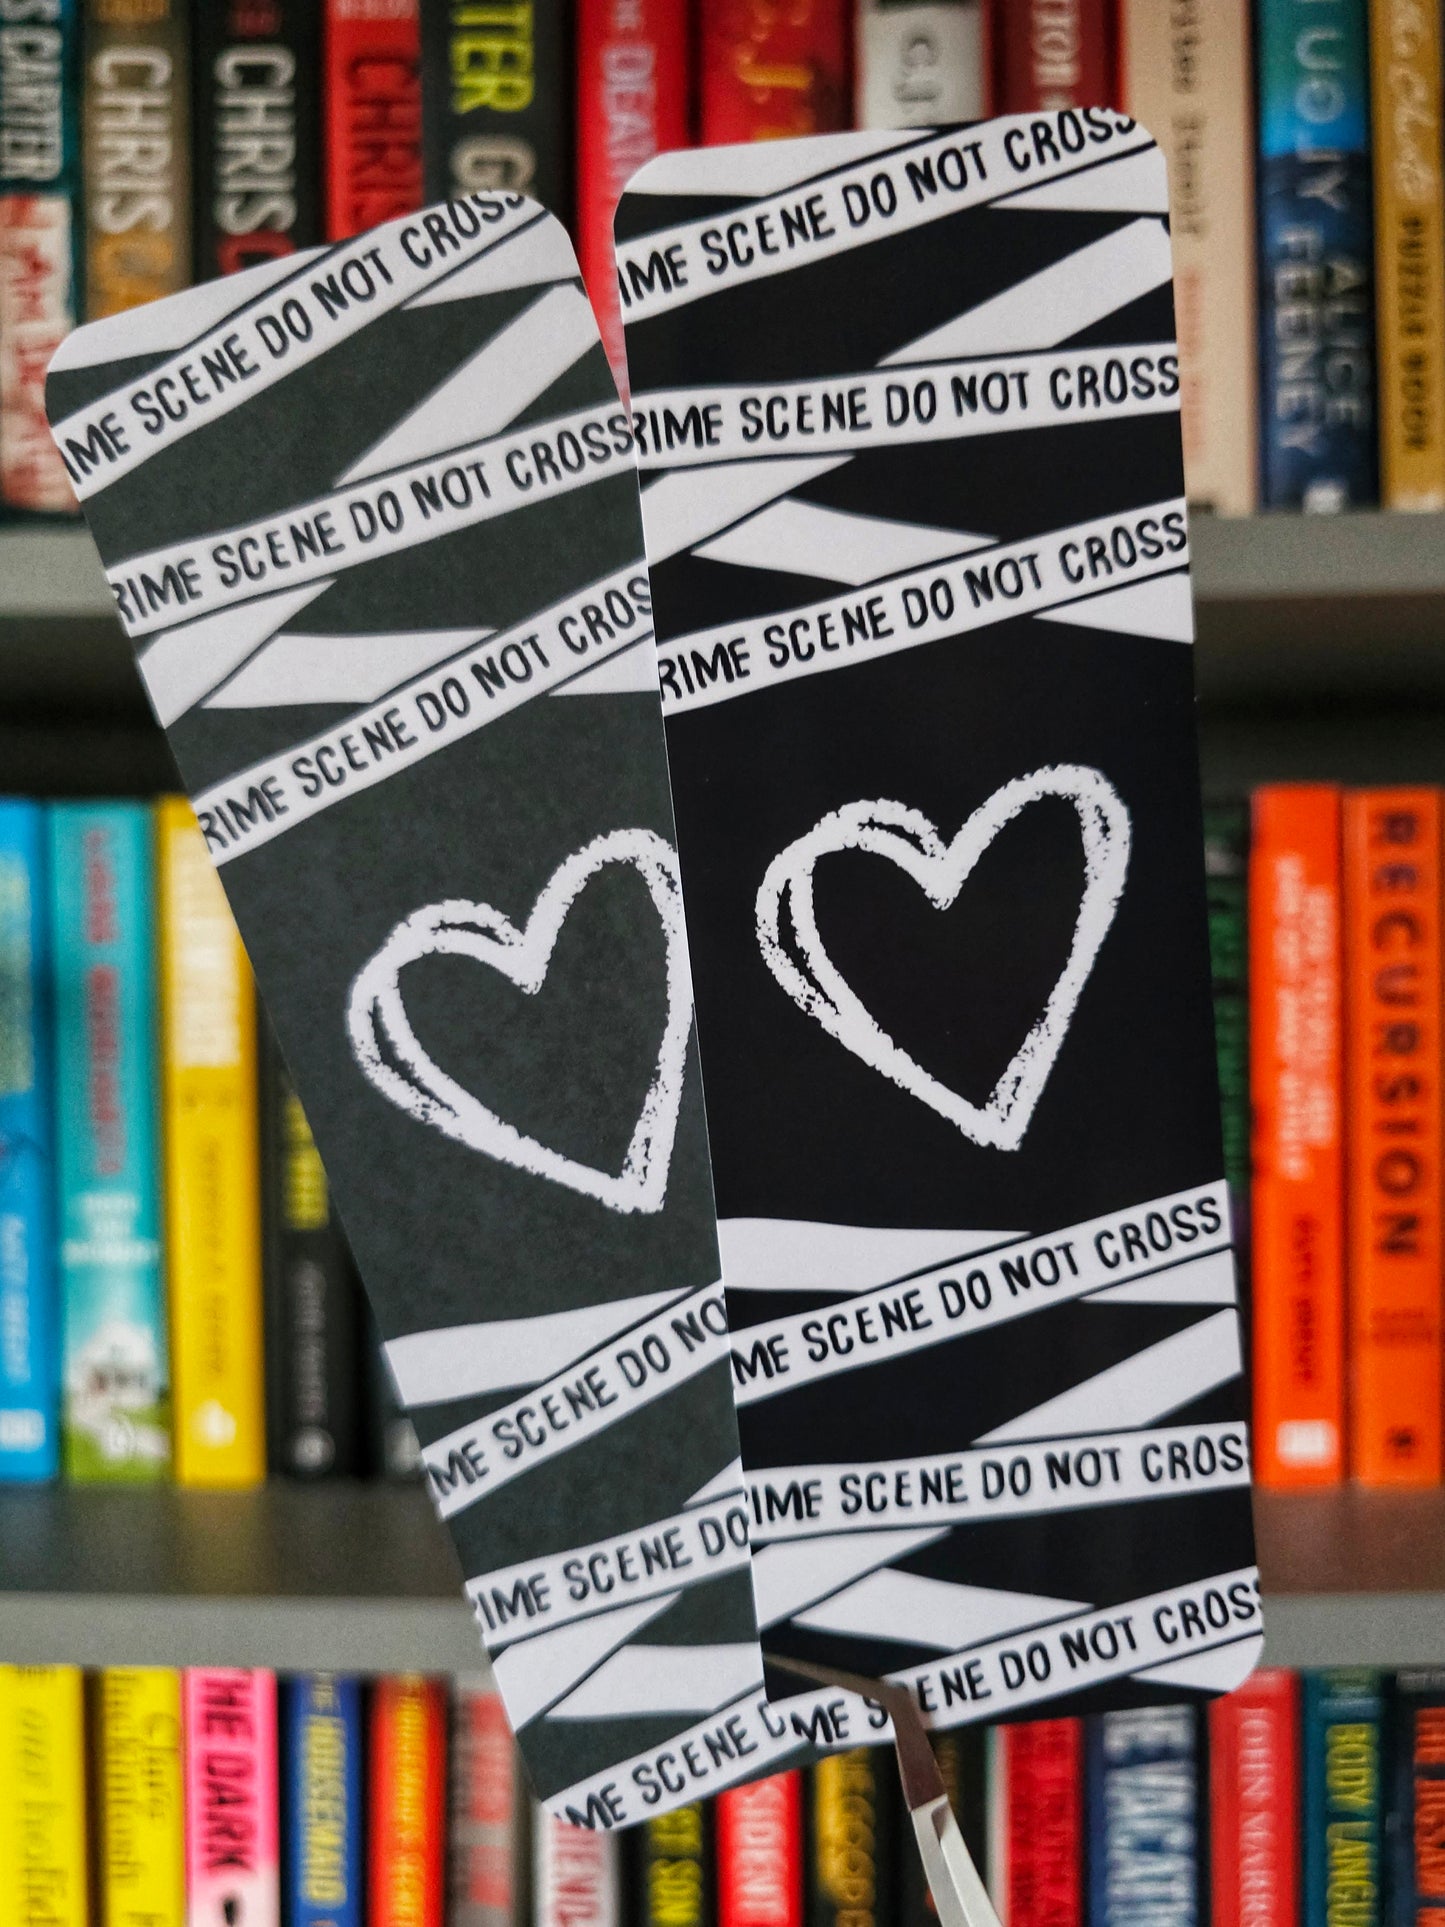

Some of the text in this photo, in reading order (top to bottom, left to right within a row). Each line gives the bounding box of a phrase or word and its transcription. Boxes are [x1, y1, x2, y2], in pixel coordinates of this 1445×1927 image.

[95, 45, 172, 234] CHRIS
[213, 45, 297, 234] CHRIS
[701, 194, 836, 277] SCENE
[841, 173, 897, 229] DO
[906, 142, 990, 202] NOT
[130, 345, 260, 436] SCENE
[255, 303, 313, 358] DO
[310, 248, 395, 321] NOT
[740, 387, 872, 442] SCENE
[885, 380, 937, 427] DO
[951, 372, 1031, 416] NOT
[1049, 356, 1180, 410] CROSS
[211, 512, 345, 587] SCENE
[349, 490, 405, 543] DO
[409, 462, 491, 519] NOT
[504, 417, 636, 490] CROSS
[656, 511, 1187, 702] RIME SCENE DO NOT CROSS
[198, 776, 290, 852] RIME
[291, 708, 418, 798] SCENE
[416, 676, 473, 732] DO
[471, 633, 552, 699] NOT
[1372, 808, 1422, 1257] RECURSION
[801, 1288, 933, 1363] SCENE
[938, 1270, 991, 1319] DO
[1000, 1241, 1080, 1297] NOT
[1094, 1196, 1221, 1269] CROSS
[492, 1366, 618, 1459] SCENE
[616, 1334, 671, 1388] DO
[671, 1294, 727, 1353] NO
[472, 1506, 750, 1631] IME SCENE DO
[746, 1480, 823, 1526] IME
[840, 1463, 968, 1517] SCENE
[981, 1456, 1032, 1502] DO
[1044, 1447, 1121, 1490] NOT
[864, 1658, 994, 1730] SENE
[1000, 1640, 1052, 1691] DO
[1066, 1614, 1141, 1671] NOT
[1152, 1578, 1262, 1643] CROS
[205, 1668, 257, 1874] HE DARK
[301, 1714, 348, 1905] HOUSEMAID
[554, 1783, 628, 1832] ME
[632, 1714, 760, 1804] SCENE
[1239, 1707, 1276, 1802] JOHN
[1326, 1722, 1379, 1810] BODY
[648, 1857, 704, 1924] SON
